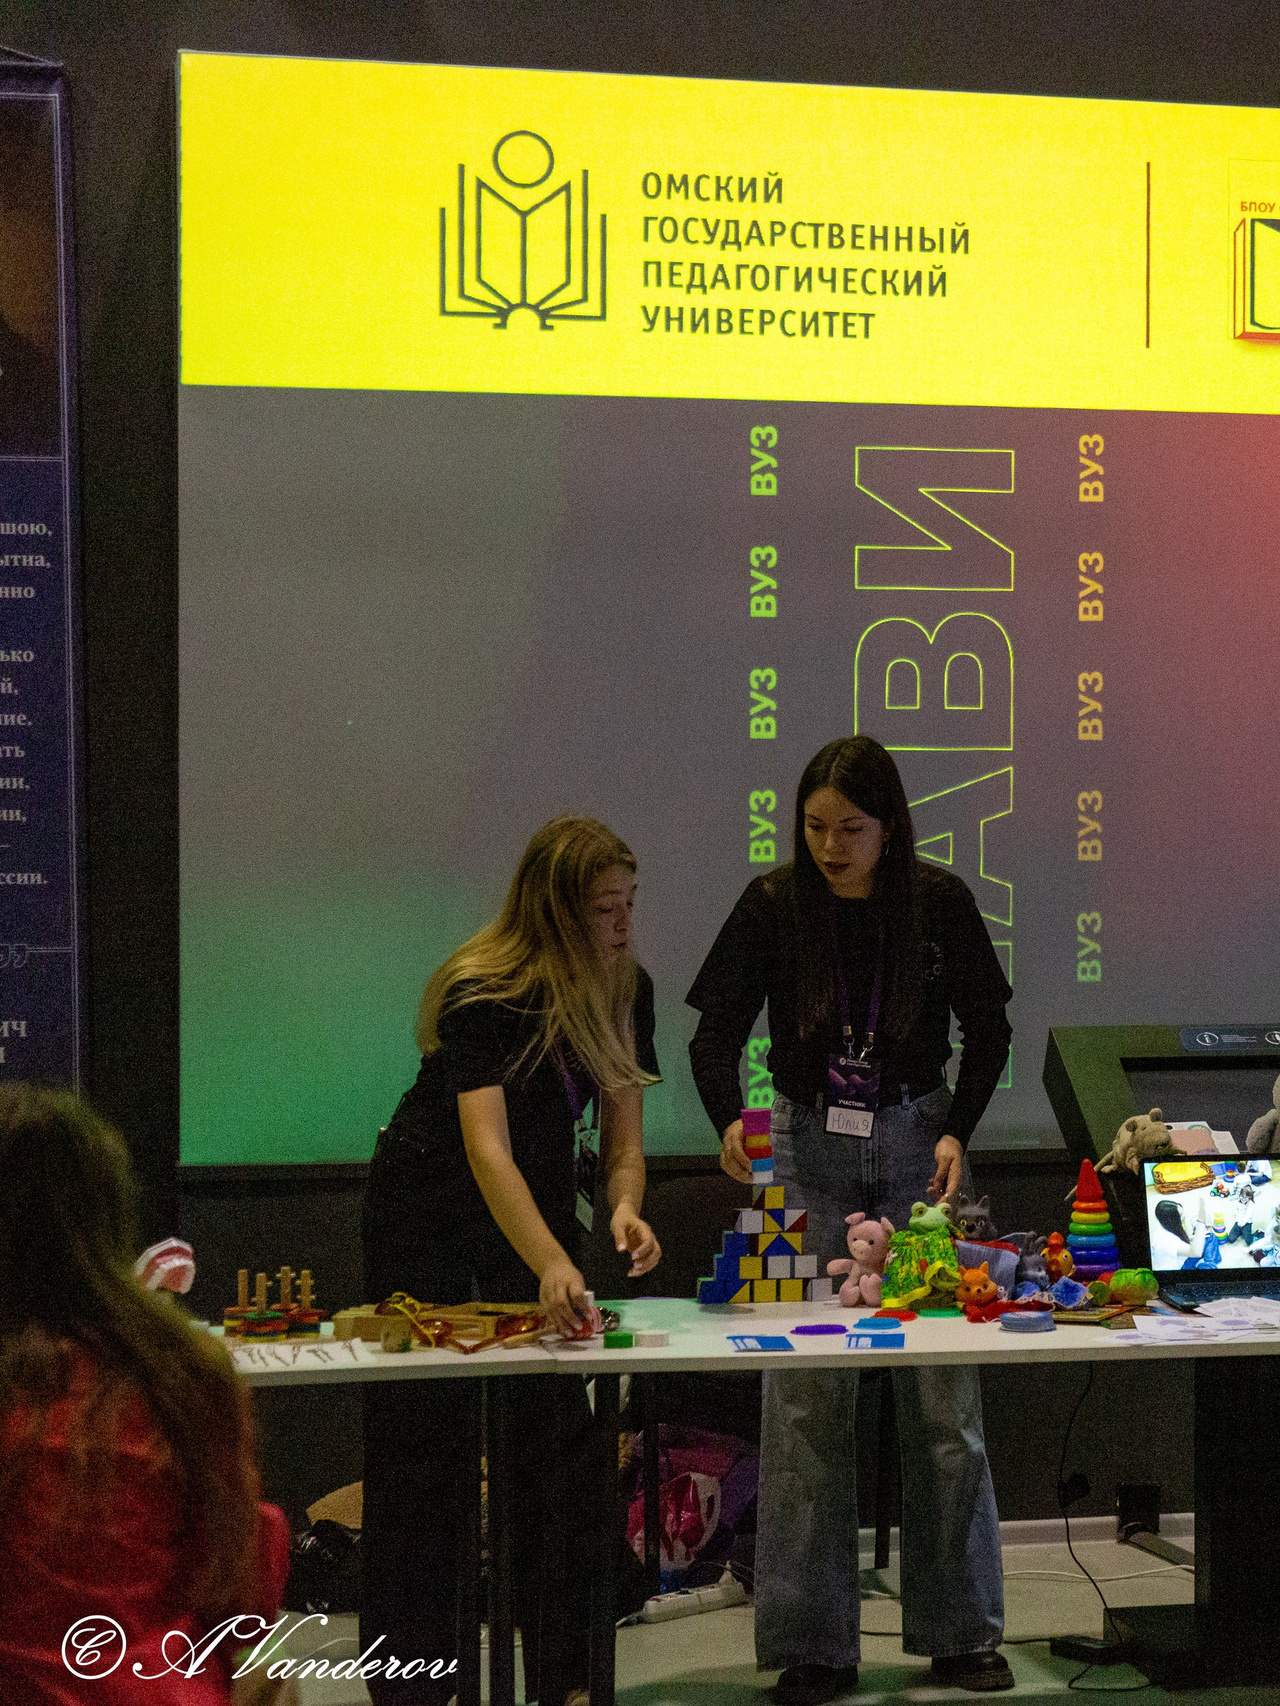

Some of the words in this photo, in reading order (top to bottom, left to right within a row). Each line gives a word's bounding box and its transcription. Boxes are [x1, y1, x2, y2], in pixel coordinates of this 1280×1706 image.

[641, 171, 784, 204] ОМСКИЙ
[1240, 201, 1276, 213] БПОУ
[642, 216, 970, 255] ГОСУДАРСТВЕННЫЙ
[642, 261, 947, 297] ПЕДАГОГИЧЕСКИЙ
[641, 305, 875, 340] УНИВЕРСИТЕТ
[750, 425, 778, 495] ВУЗ
[1079, 434, 1104, 502] ВУЗ
[750, 546, 778, 617] ВУЗ
[1079, 552, 1104, 621] ВУЗ
[749, 668, 777, 739] ВУЗ
[1078, 671, 1103, 740] ВУЗ
[749, 789, 776, 862] ВУЗ
[1078, 790, 1102, 861] ВУЗ
[1077, 911, 1101, 982] ВУЗ
